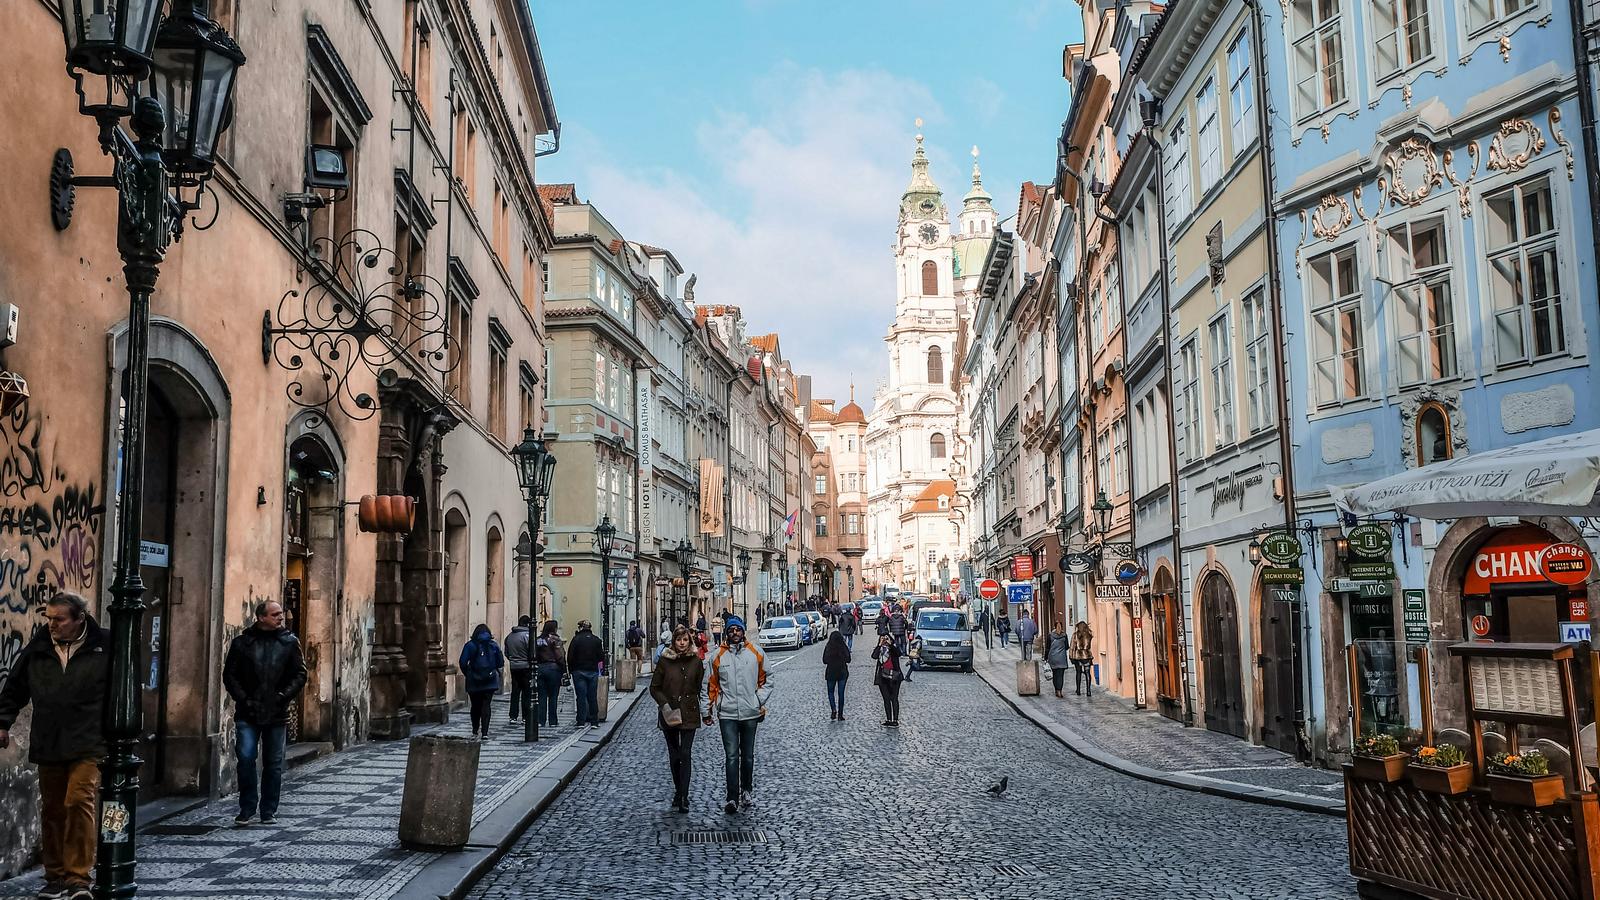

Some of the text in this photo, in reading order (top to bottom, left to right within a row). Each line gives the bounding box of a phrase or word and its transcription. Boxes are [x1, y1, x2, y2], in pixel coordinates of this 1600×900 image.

[1368, 478, 1444, 502] RESTAURANT
[1443, 475, 1473, 490] POD
[1352, 526, 1387, 538] TOURIST INFO
[1265, 535, 1298, 545] TOURIST INFO
[1546, 546, 1584, 559] change
[1475, 550, 1541, 578] CHAN
[1095, 585, 1130, 598] CHANGE
[1277, 591, 1295, 601] WC
[1366, 584, 1386, 596] WC
[1352, 604, 1379, 614] TOURIST
[1404, 612, 1427, 620] HOSTEL
